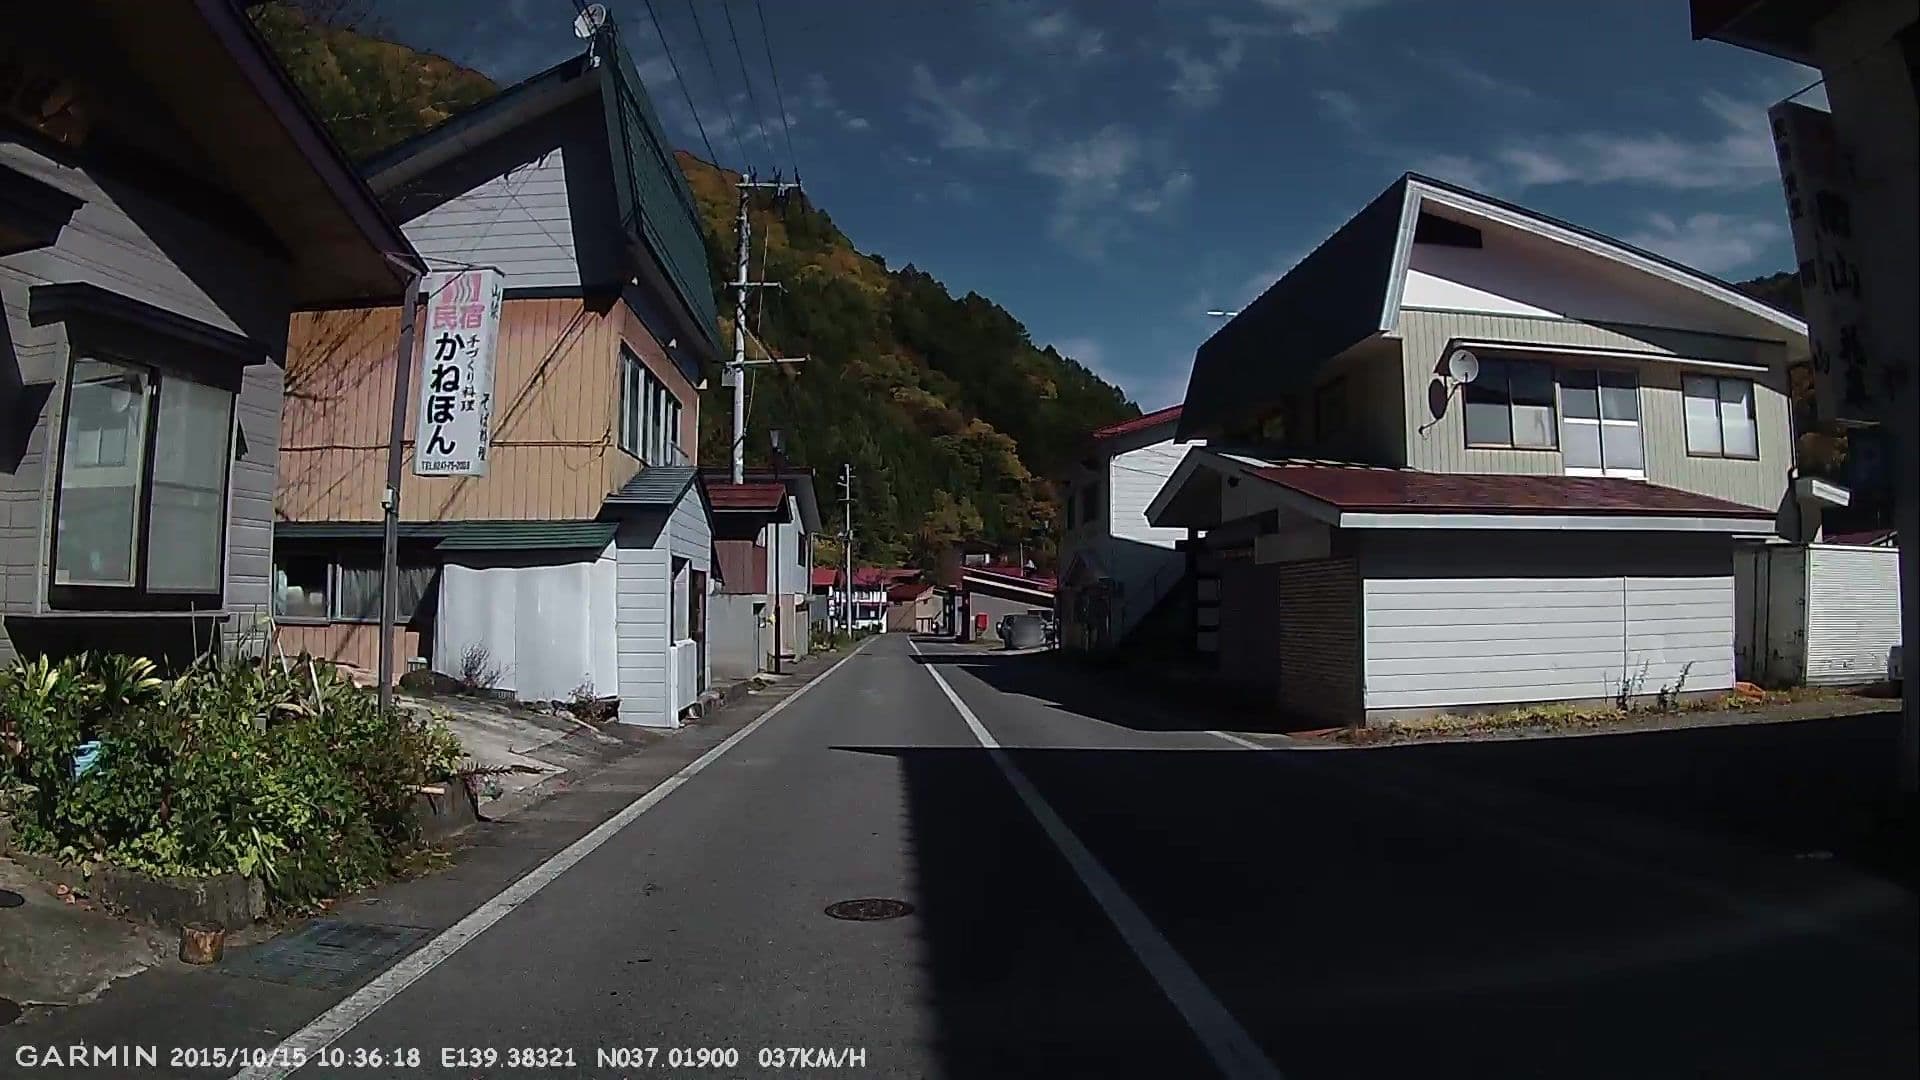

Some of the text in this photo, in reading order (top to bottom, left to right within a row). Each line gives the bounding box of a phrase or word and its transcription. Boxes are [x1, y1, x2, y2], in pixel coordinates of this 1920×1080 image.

[433, 303, 486, 331] 民宿
[426, 332, 466, 456] かねほん
